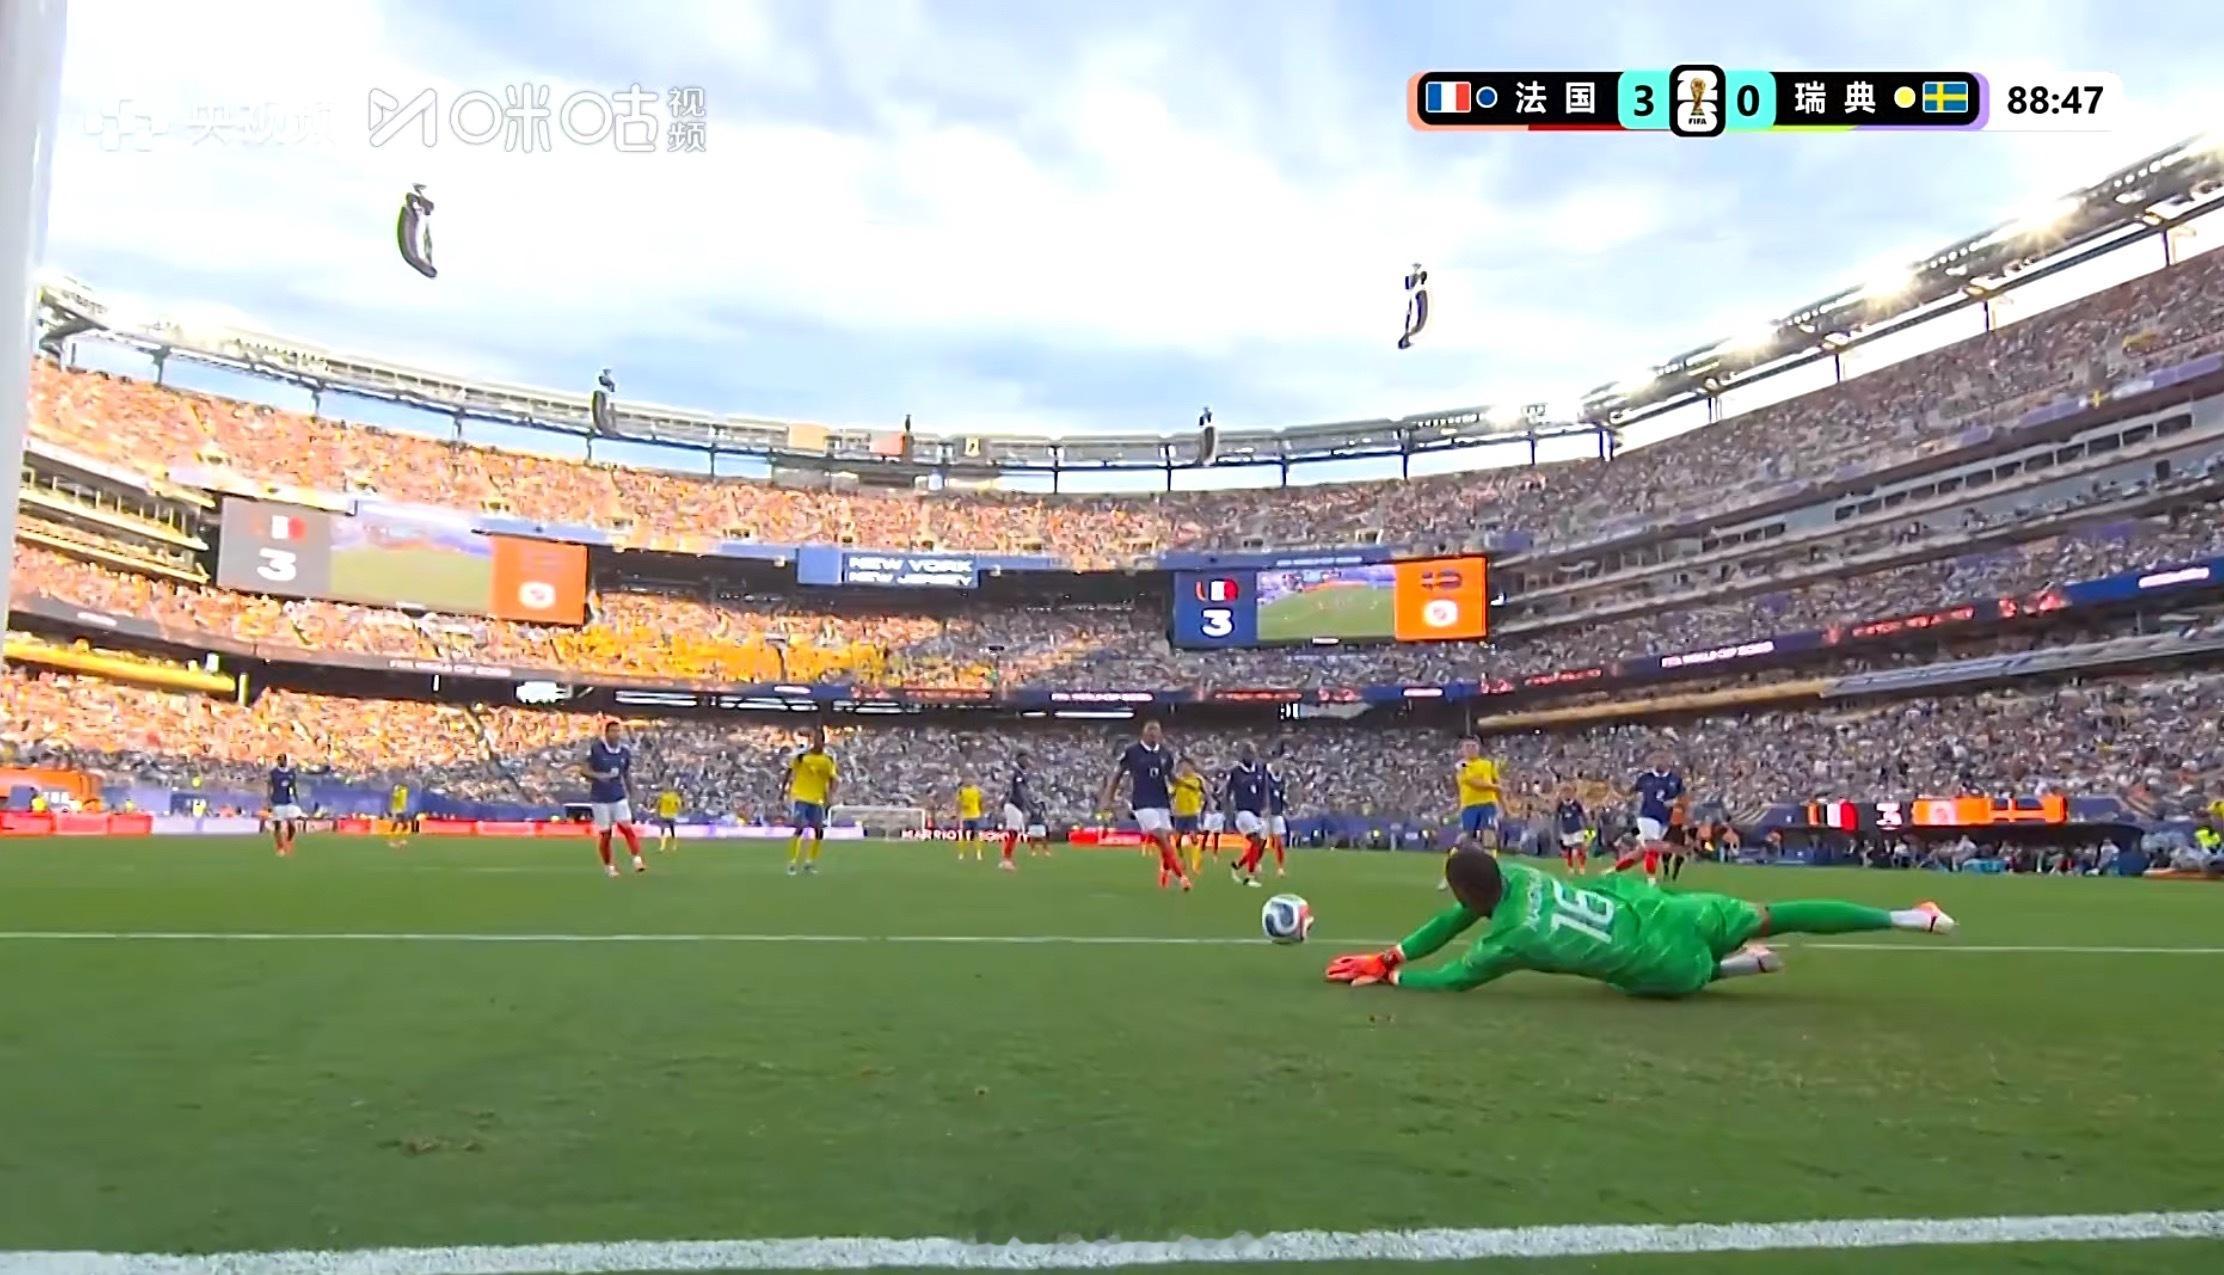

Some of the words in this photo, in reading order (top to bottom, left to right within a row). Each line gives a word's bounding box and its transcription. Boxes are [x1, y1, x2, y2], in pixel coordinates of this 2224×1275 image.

[257, 548, 297, 581] 3
[848, 556, 904, 572] NEW
[908, 559, 973, 573] YORK
[1201, 608, 1234, 638] 3
[1551, 879, 1615, 944] 16
